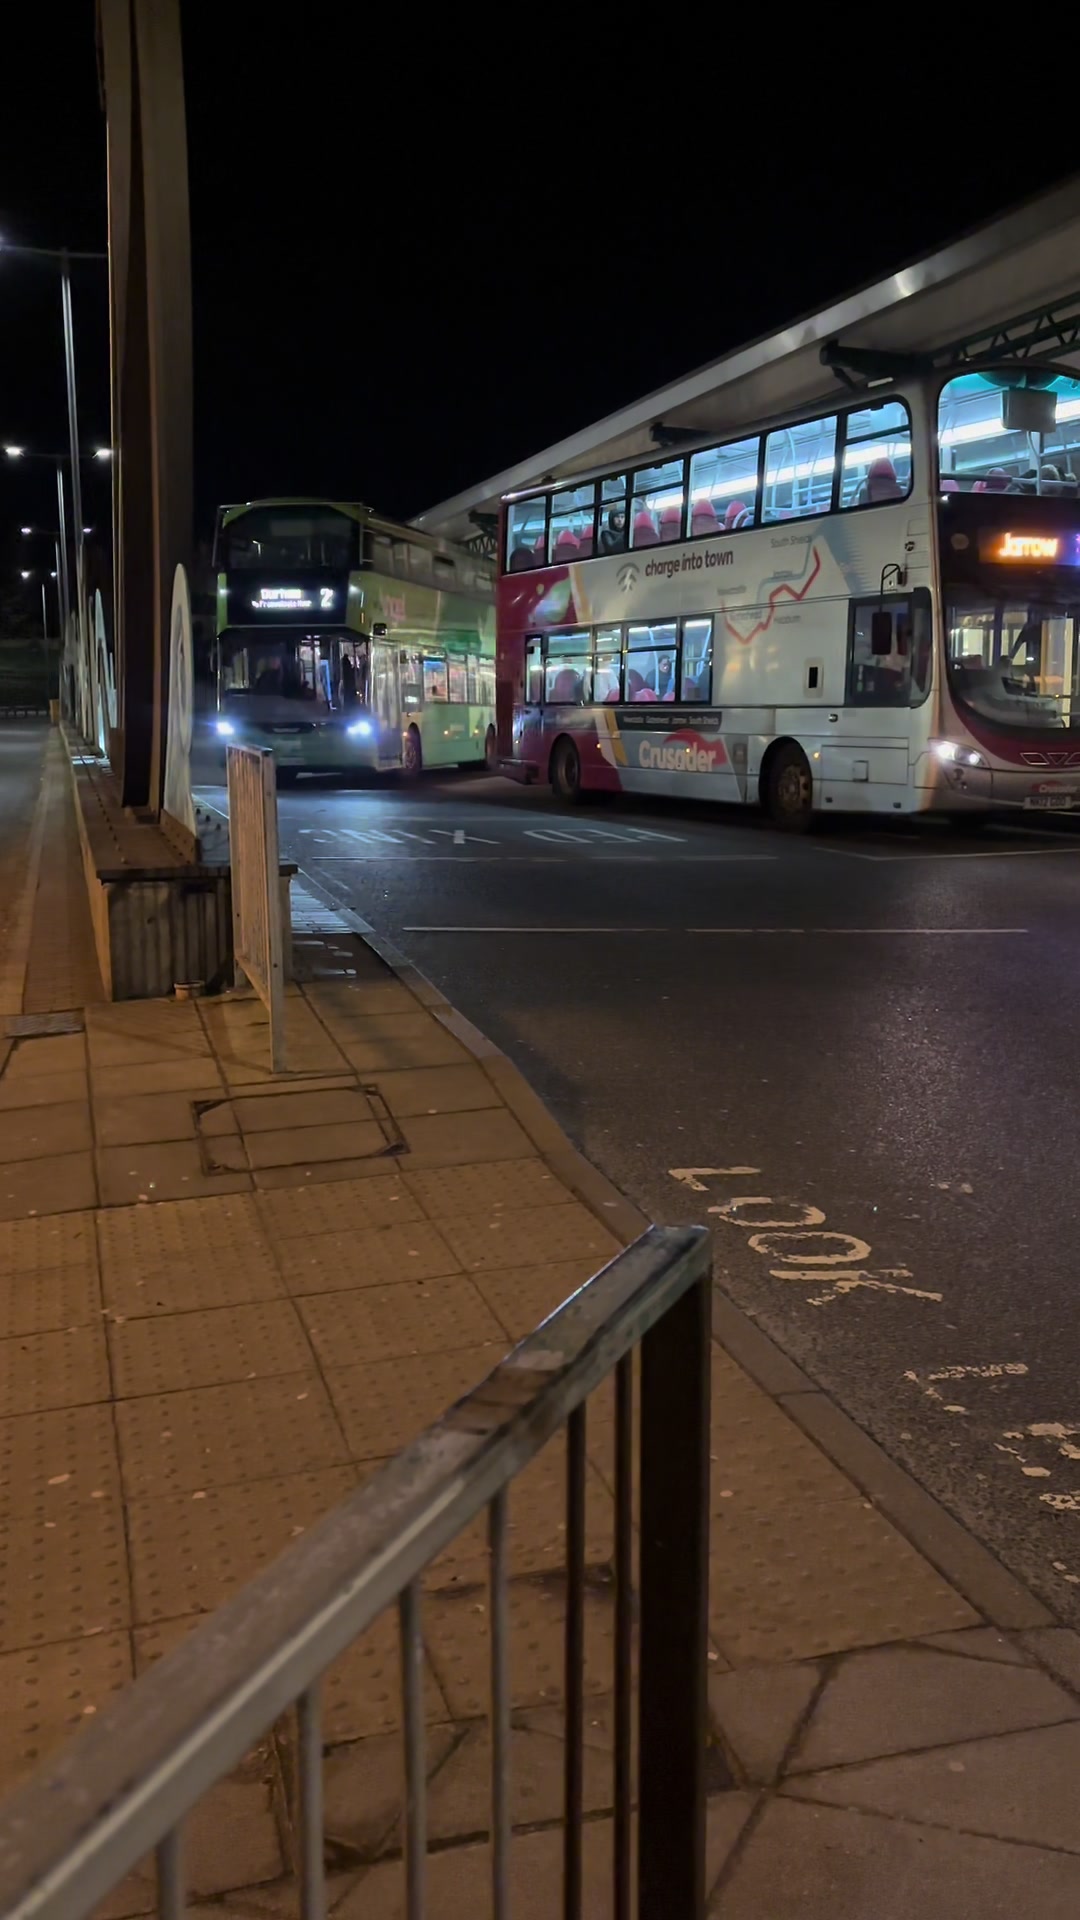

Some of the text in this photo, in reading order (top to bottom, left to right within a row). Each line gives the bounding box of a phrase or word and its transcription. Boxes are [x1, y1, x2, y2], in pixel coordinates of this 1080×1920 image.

[645, 550, 734, 578] charge into town
[639, 739, 717, 772] Crusader
[668, 1165, 944, 1307] LOOK
